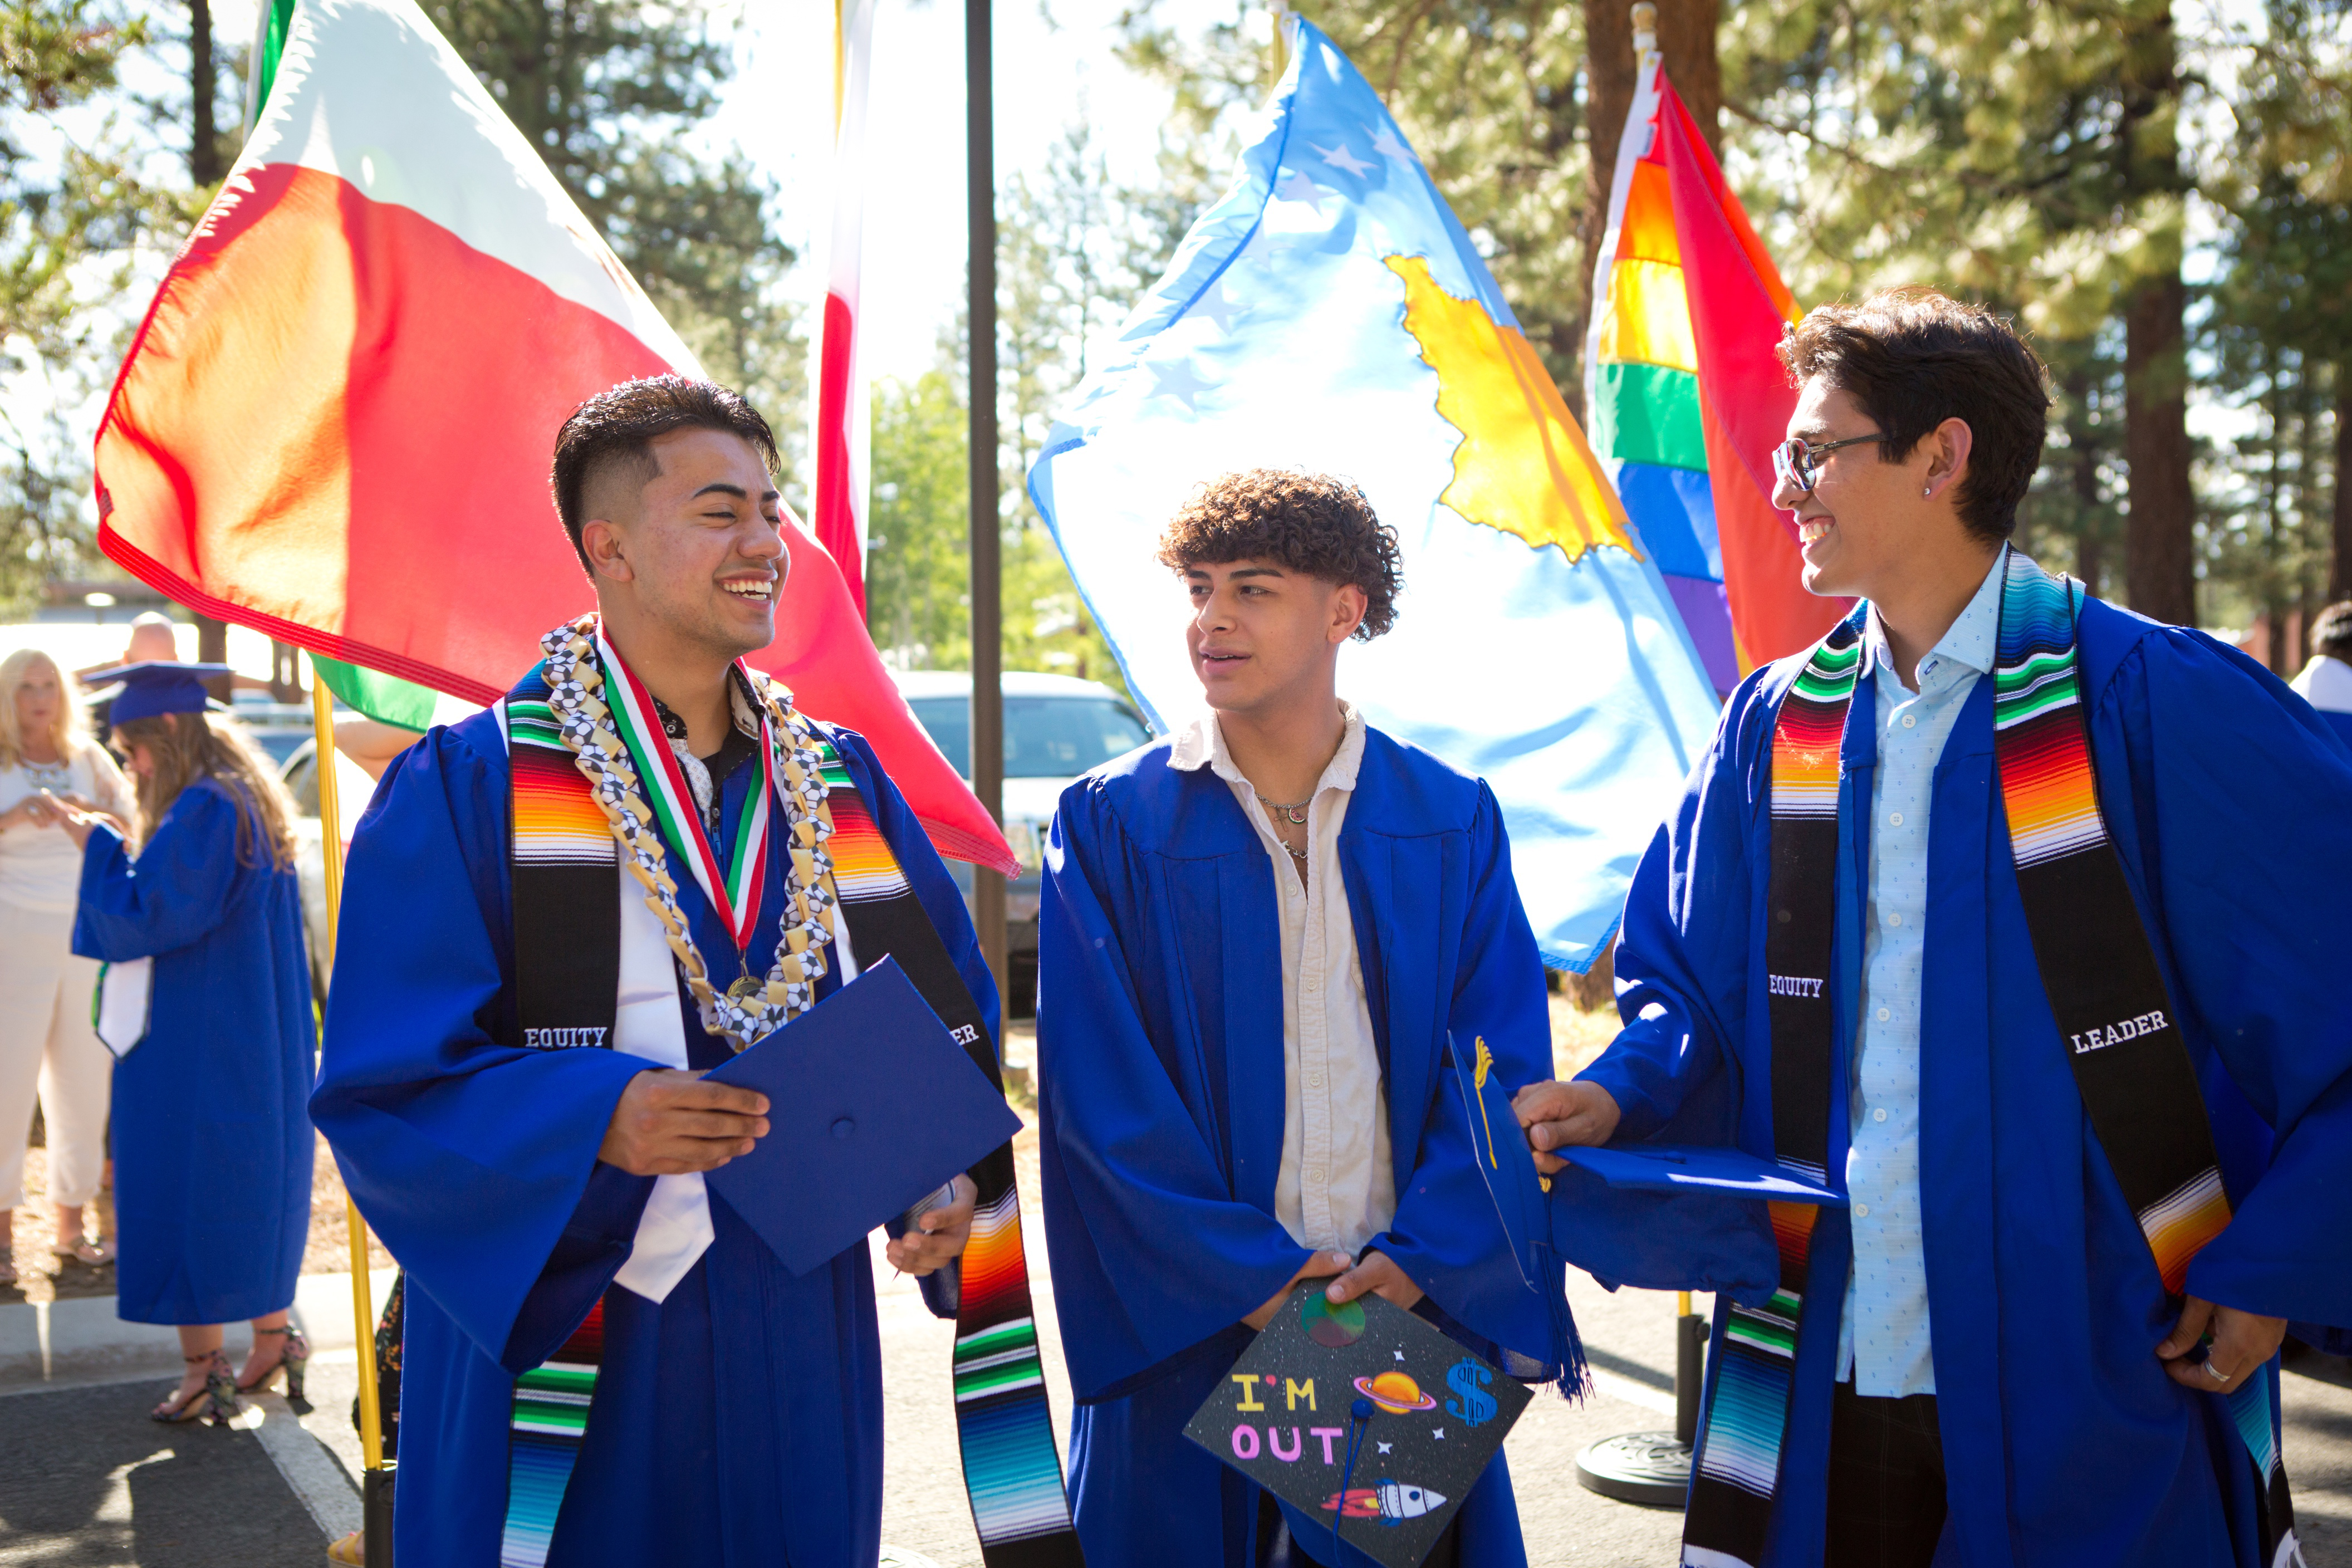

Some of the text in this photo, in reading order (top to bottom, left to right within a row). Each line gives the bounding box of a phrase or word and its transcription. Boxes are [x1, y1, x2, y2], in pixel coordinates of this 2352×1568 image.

[1769, 974, 1824, 998] EQUITY
[524, 1027, 607, 1048] EQUITY
[949, 1023, 979, 1046] ER
[2070, 1010, 2169, 1054] LEADER
[1232, 1374, 1316, 1412] I'M
[1232, 1424, 1343, 1465] OUT
